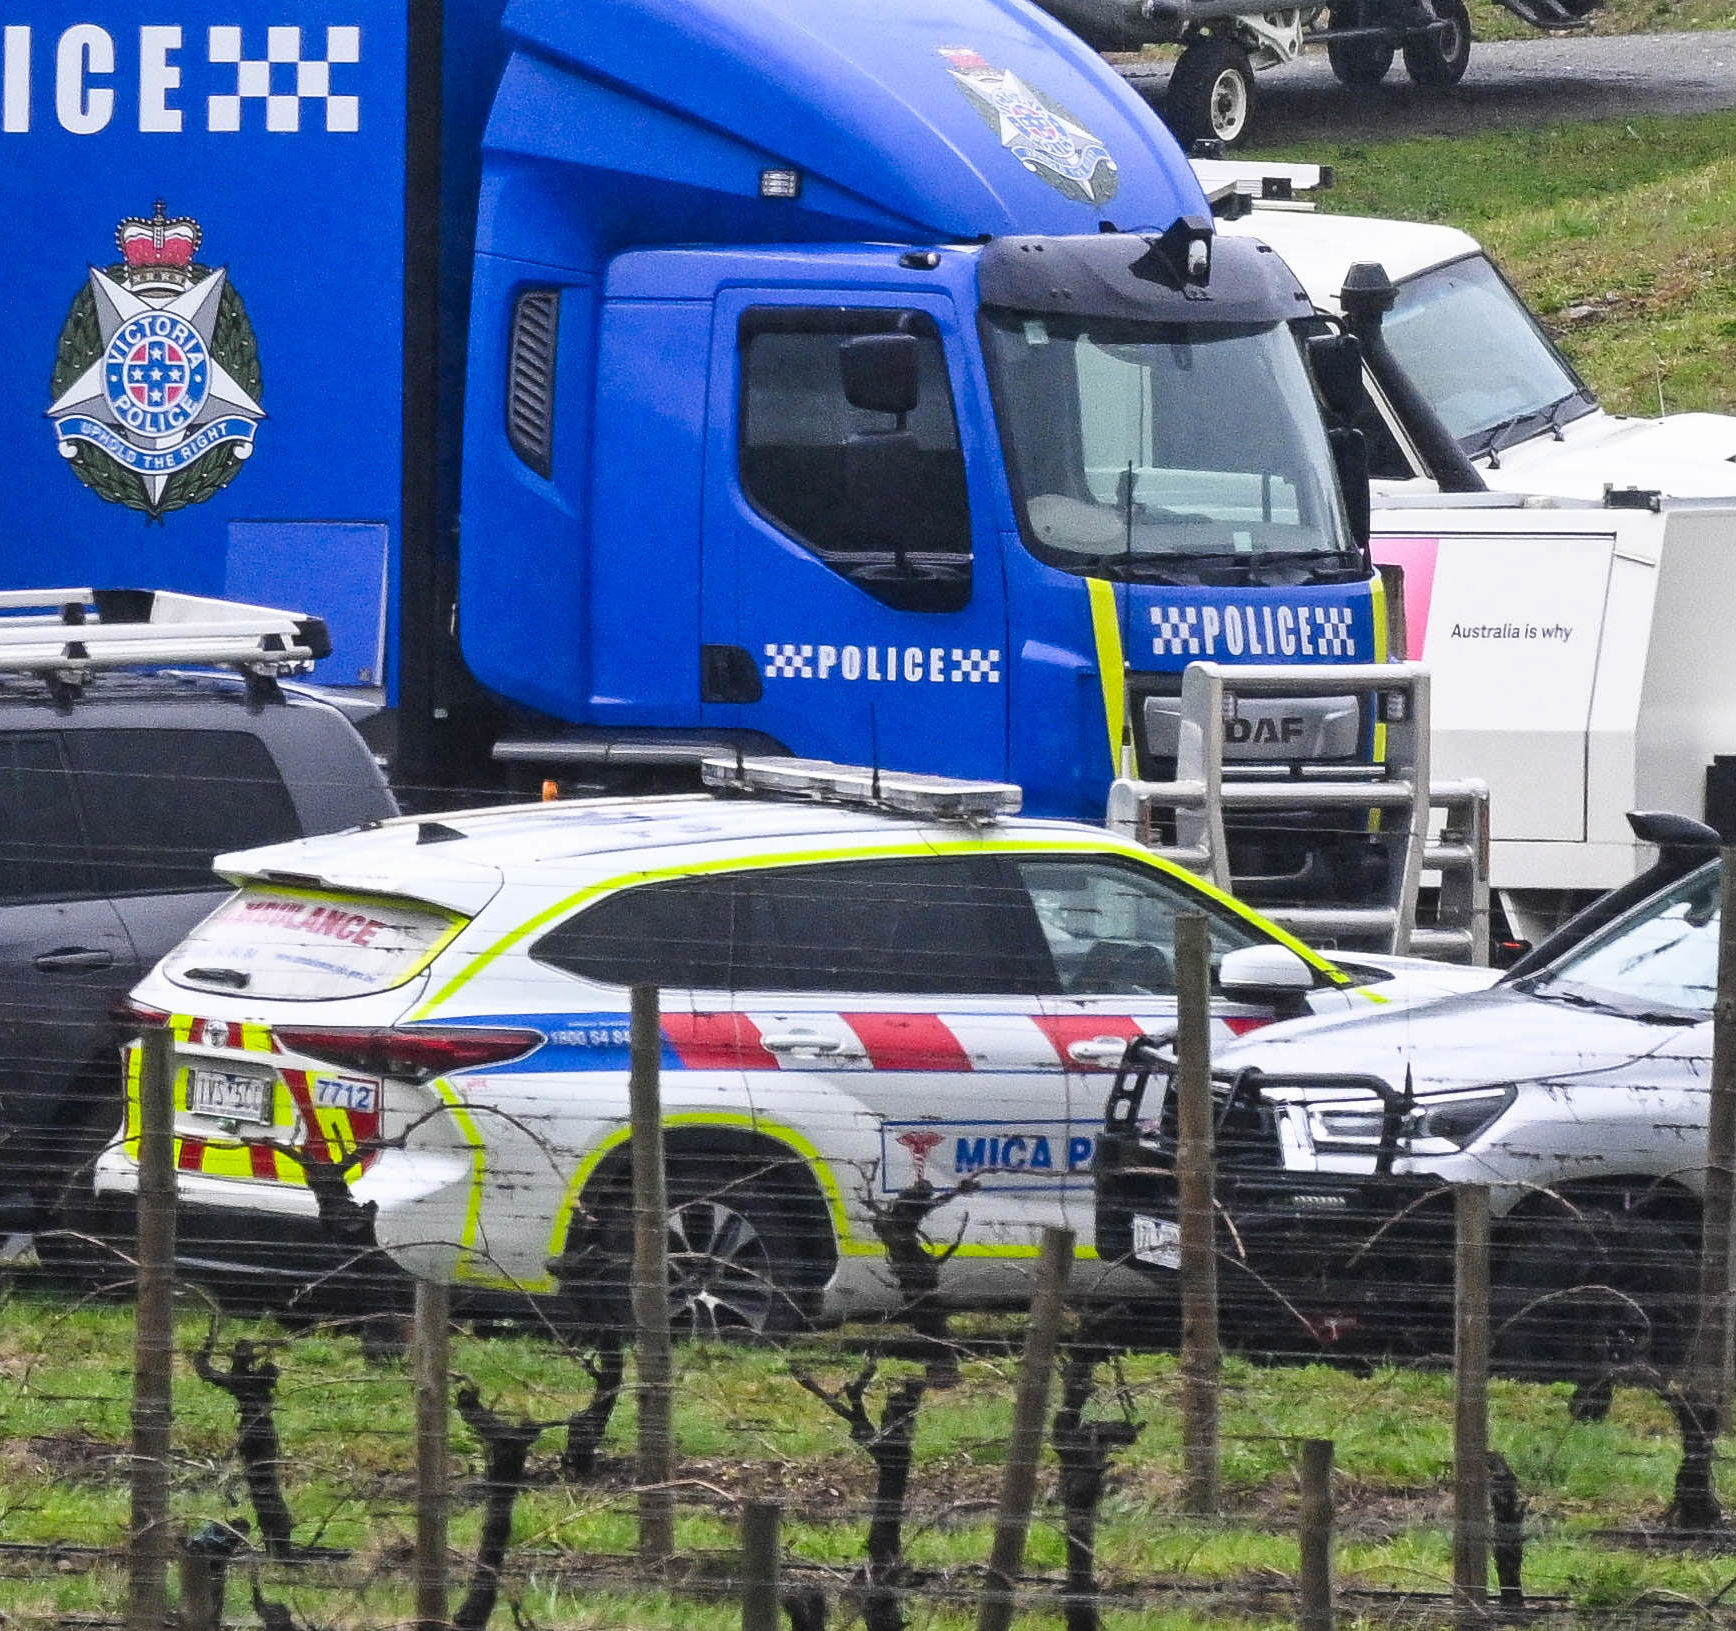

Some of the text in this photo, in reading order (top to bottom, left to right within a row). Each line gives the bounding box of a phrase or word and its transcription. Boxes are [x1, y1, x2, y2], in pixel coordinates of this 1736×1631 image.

[108, 317, 205, 370] VICTORIA
[114, 395, 199, 433] POLICE
[80, 421, 228, 470] UPHOLD THE RIGHT
[1201, 605, 1314, 656] POLICE
[1450, 623, 1573, 643] Australia is why
[818, 644, 945, 683] POLICE
[1224, 717, 1305, 744] DAF
[318, 1079, 373, 1111] 7712
[953, 1136, 1052, 1173] MICA
